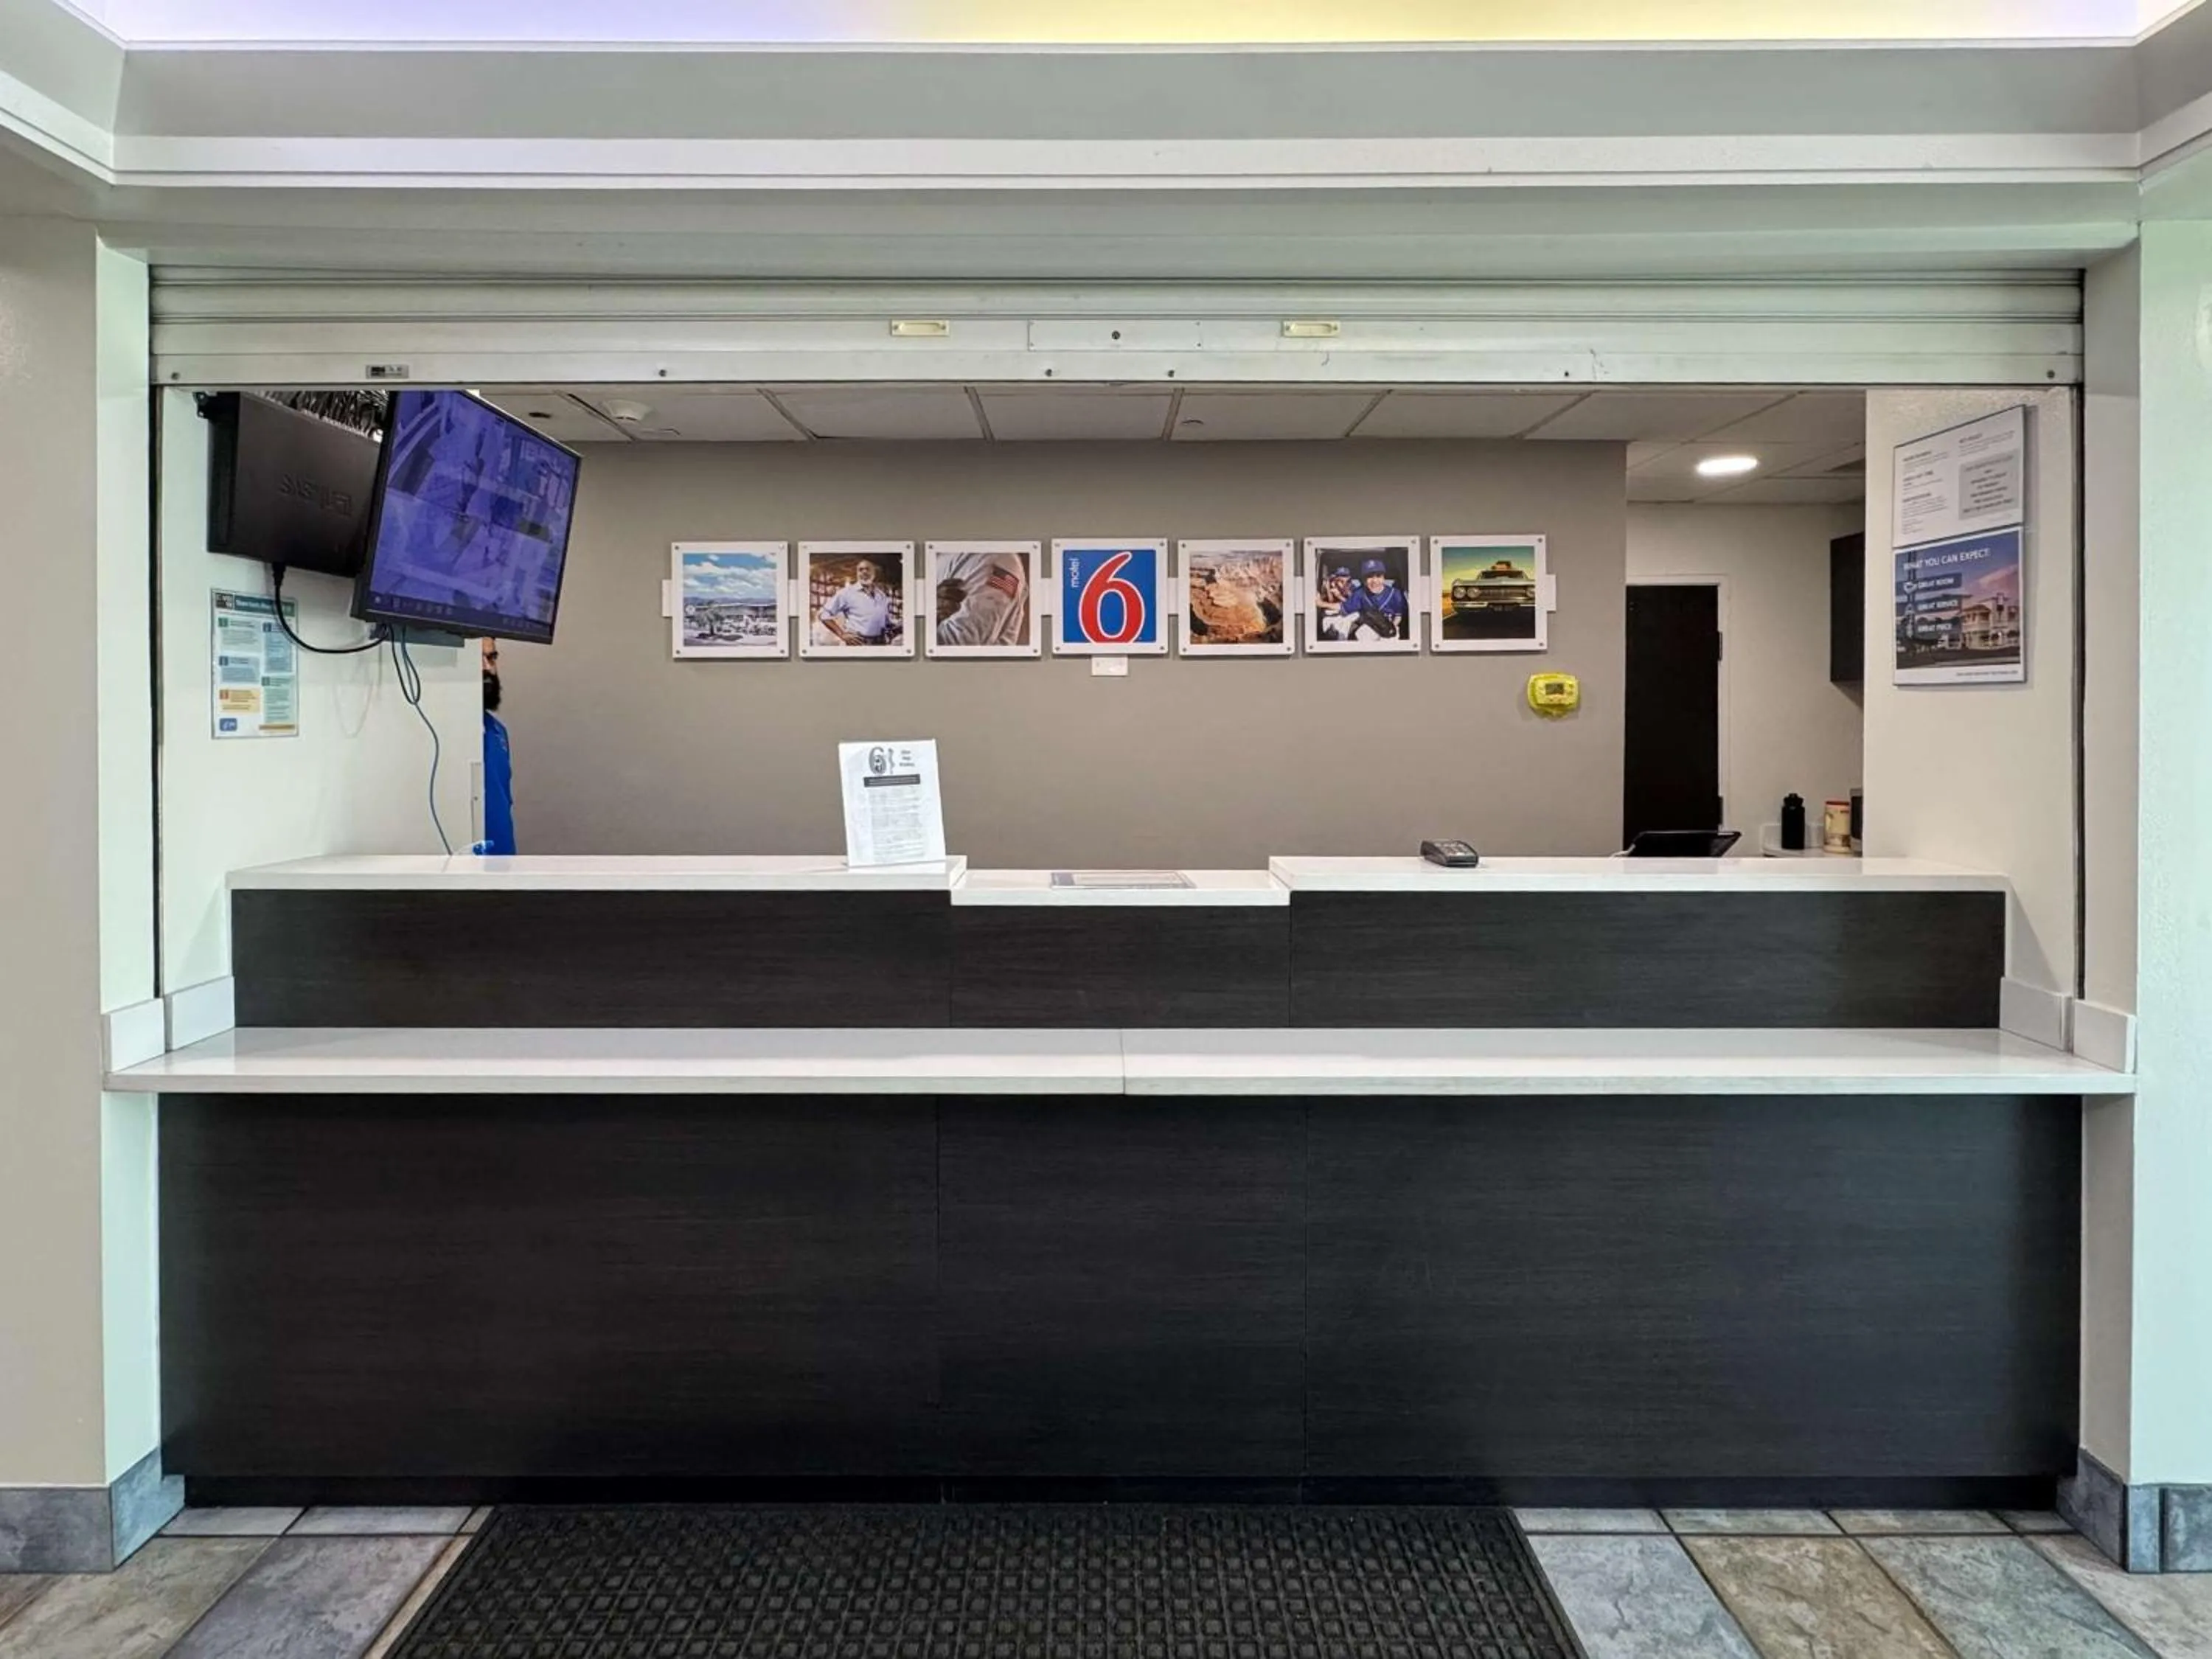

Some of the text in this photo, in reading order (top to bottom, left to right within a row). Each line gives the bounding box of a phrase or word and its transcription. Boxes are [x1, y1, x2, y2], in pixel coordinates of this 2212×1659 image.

[1069, 557, 1080, 588] motel
[1924, 557, 1940, 566] YOU
[1941, 554, 1958, 564] CAN
[1079, 552, 1145, 645] 6
